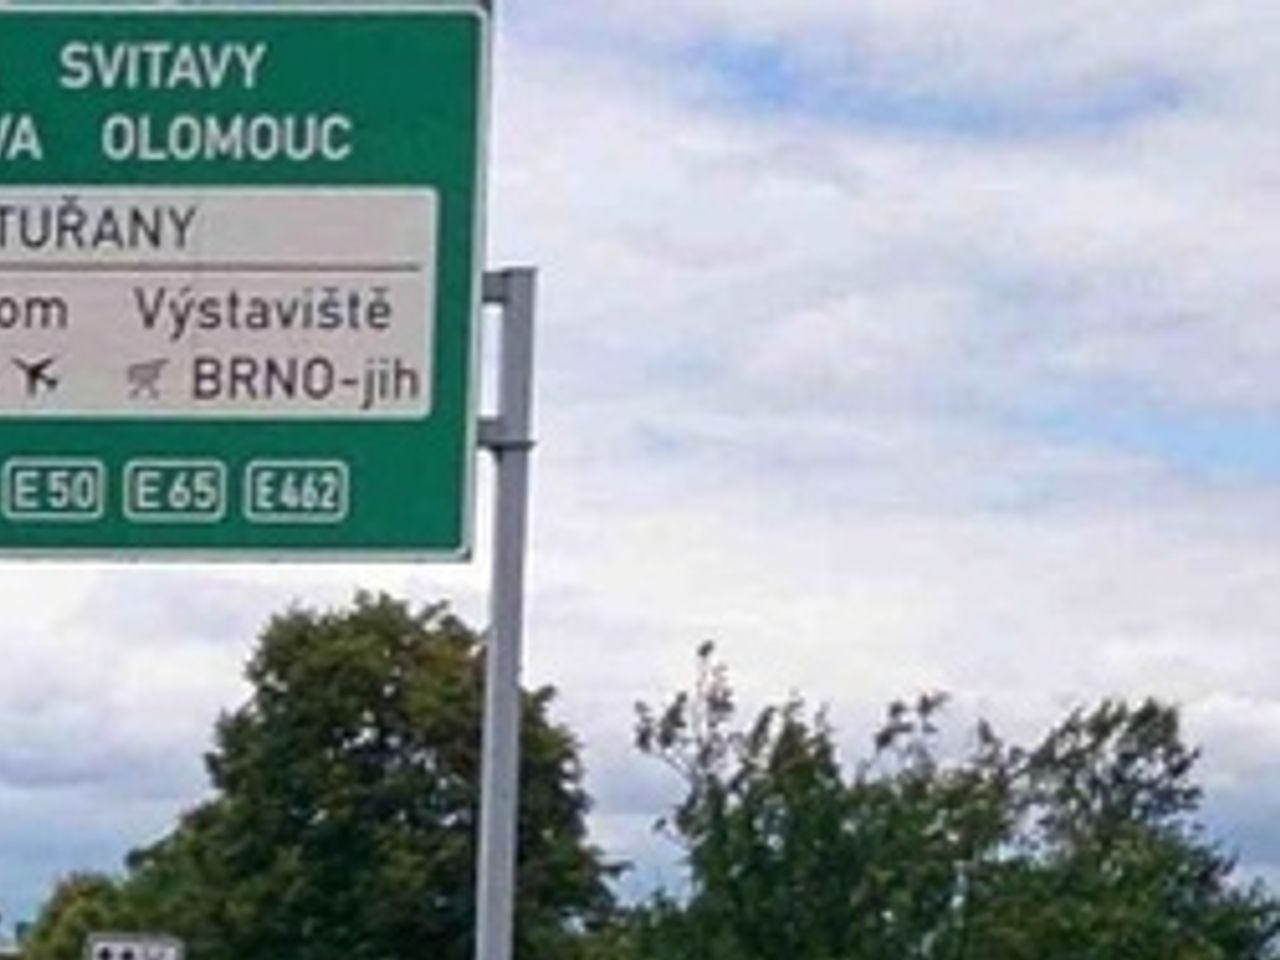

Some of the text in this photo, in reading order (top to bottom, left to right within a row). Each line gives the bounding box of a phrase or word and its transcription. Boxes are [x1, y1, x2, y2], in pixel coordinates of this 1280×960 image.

[59, 41, 267, 89] SVITAVY
[101, 113, 352, 161] OLOMOUC
[133, 285, 393, 342] Výstaviště
[192, 355, 420, 411] BRNO-jih
